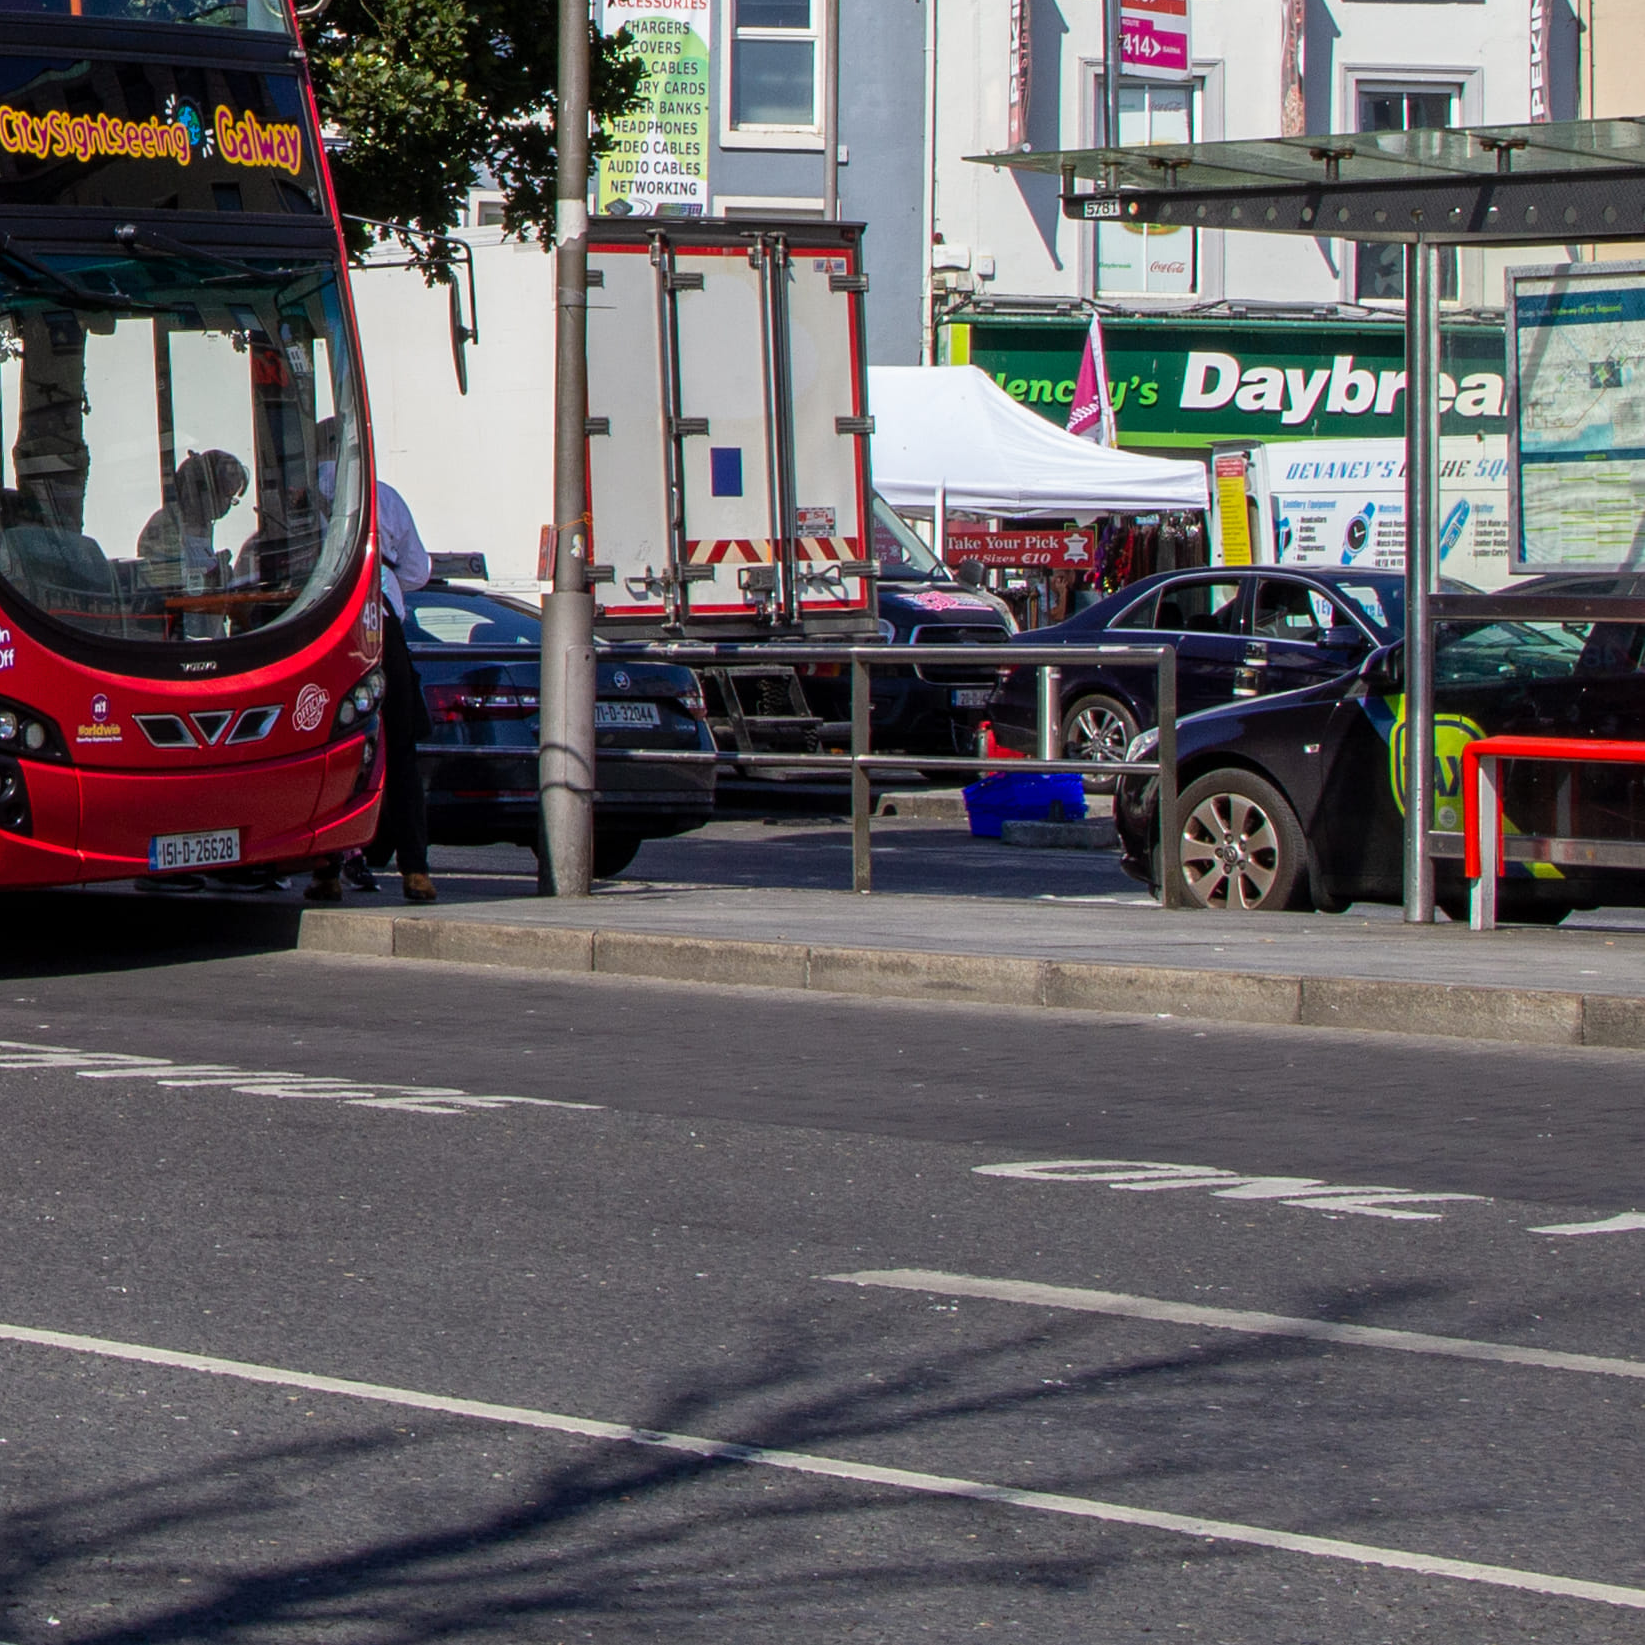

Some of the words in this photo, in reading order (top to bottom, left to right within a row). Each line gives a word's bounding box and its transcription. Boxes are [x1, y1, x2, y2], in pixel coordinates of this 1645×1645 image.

[624, 20, 690, 35] CHARGERS
[632, 40, 682, 55] COVERS
[1123, 33, 1151, 57] 414
[651, 61, 699, 75] CABLES
[664, 82, 706, 96] CARDS
[659, 101, 701, 115] BANKS
[613, 120, 698, 135] HEADPHONES
[215, 104, 301, 175] Galway
[613, 140, 649, 154] IDEO
[653, 141, 701, 155] CABLES
[607, 160, 649, 174] AUDIO
[653, 161, 701, 175] CABLES
[610, 181, 698, 196] NETWORKING
[1086, 202, 1117, 216] 5781
[1286, 460, 1397, 480] DEVANEY'S
[1439, 460, 1471, 478] HE
[947, 536, 981, 550] Take
[986, 536, 1021, 550] Your
[1025, 535, 1059, 549] Pick
[982, 554, 1016, 563] Sizes
[1021, 553, 1051, 564] €10
[362, 601, 379, 631] 48
[295, 693, 330, 726] OFFICIAL
[595, 704, 654, 722] 71-D-32044
[162, 835, 233, 866] 151-D-26628
